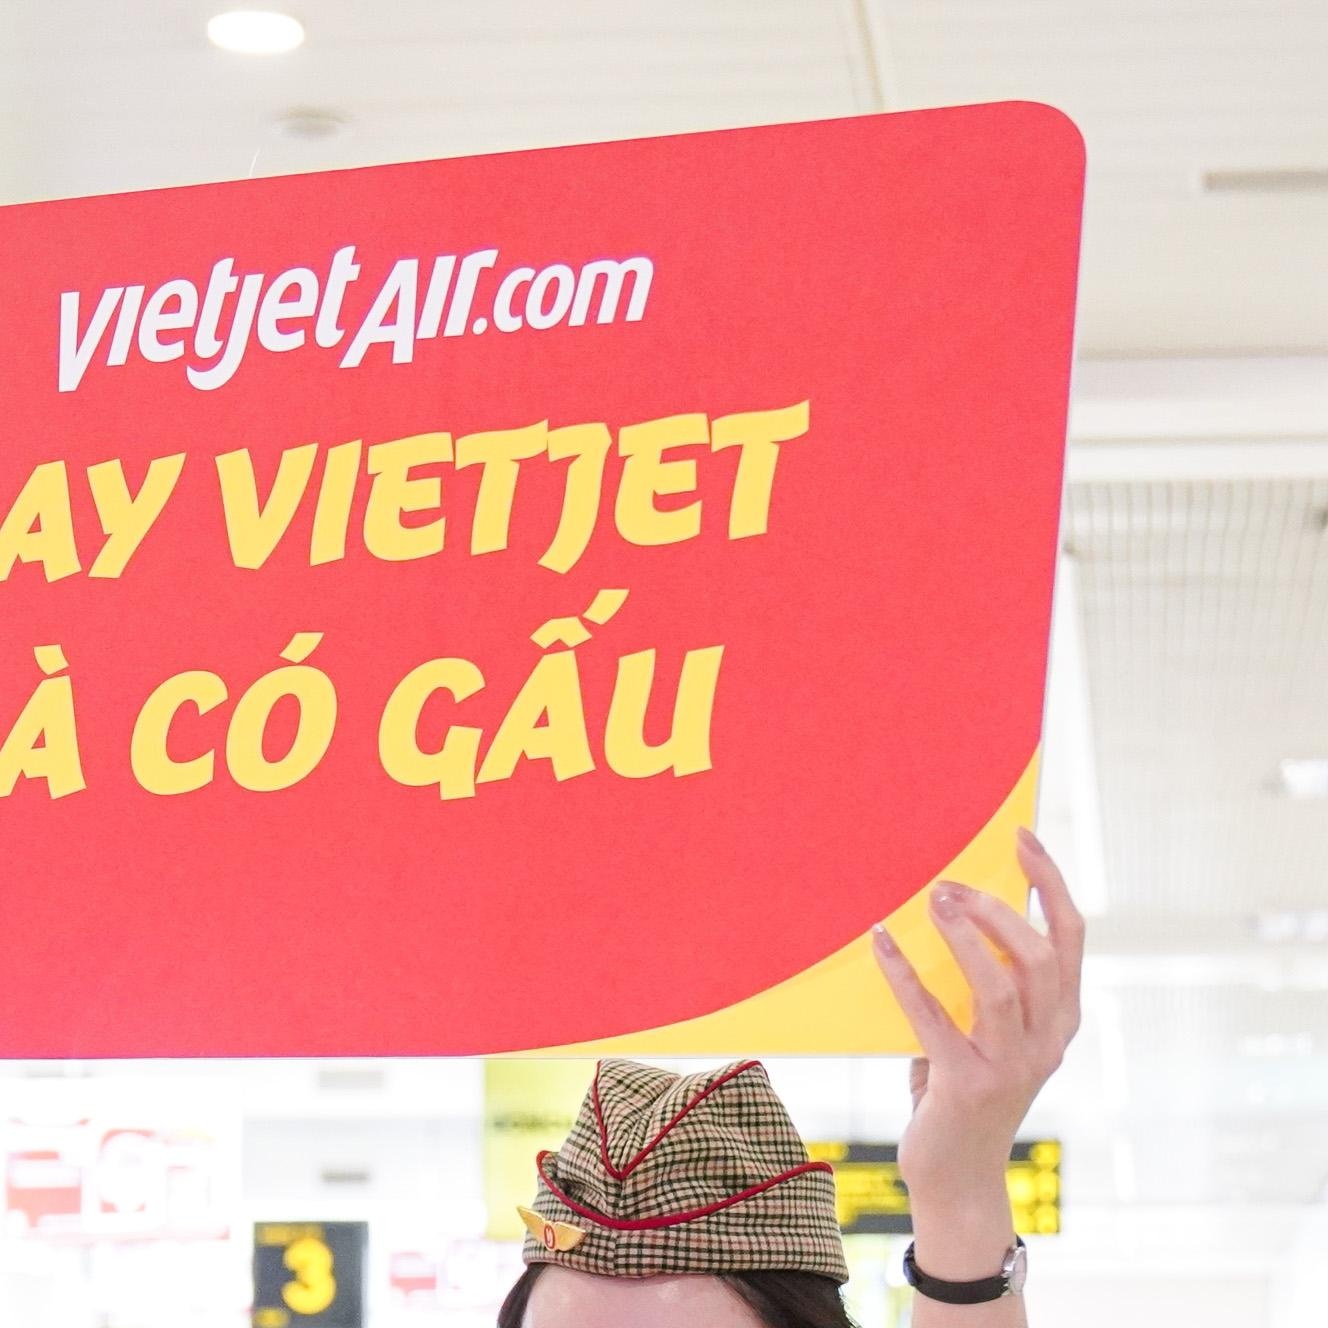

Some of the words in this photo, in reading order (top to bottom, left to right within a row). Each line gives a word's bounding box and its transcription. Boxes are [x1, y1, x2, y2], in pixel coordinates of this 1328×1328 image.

[215, 401, 809, 573] VIETJET
[131, 633, 336, 796] CÓ
[379, 588, 724, 800] GẤU
[282, 1236, 337, 1315] 3
